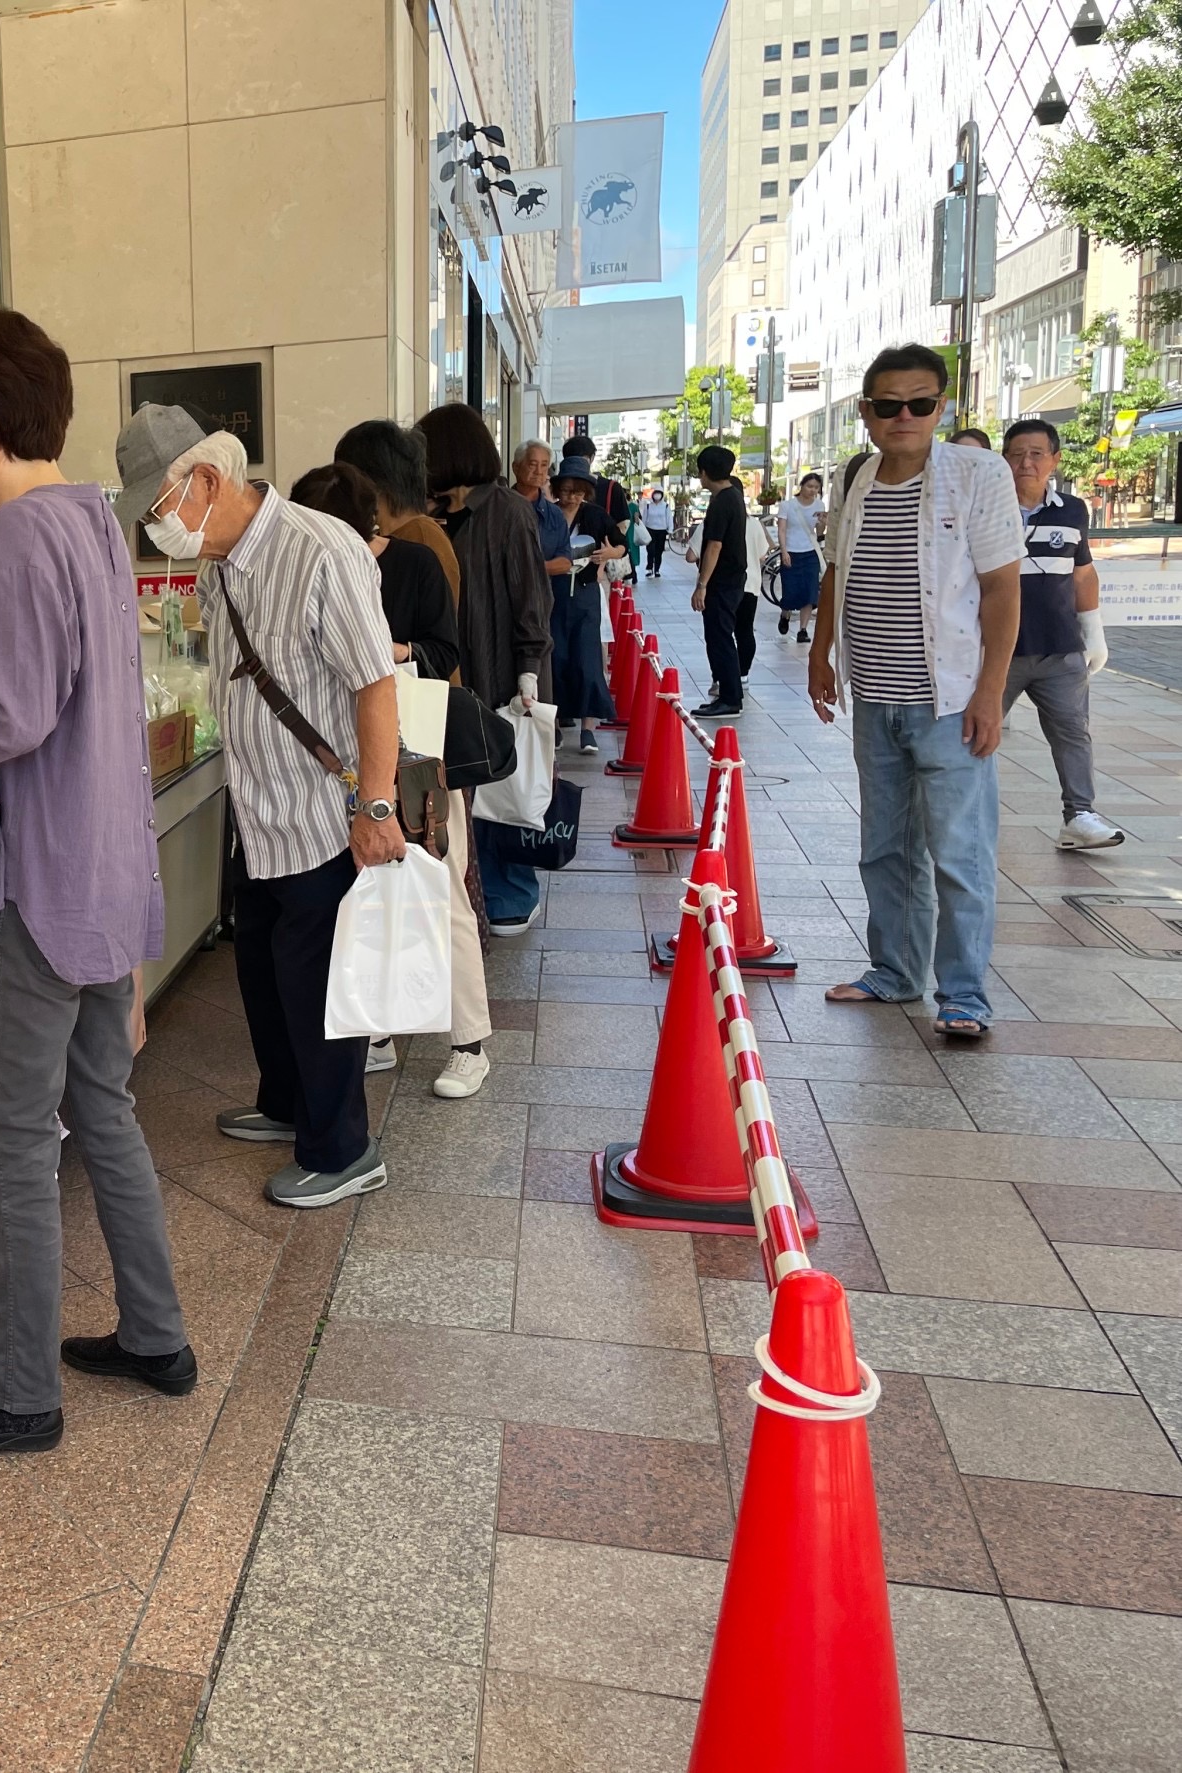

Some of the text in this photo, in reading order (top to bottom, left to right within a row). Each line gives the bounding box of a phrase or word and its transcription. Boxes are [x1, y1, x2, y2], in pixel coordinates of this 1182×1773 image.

[581, 172, 614, 205] HUNTING
[602, 205, 634, 225] WORLD
[178, 583, 197, 596] NO
